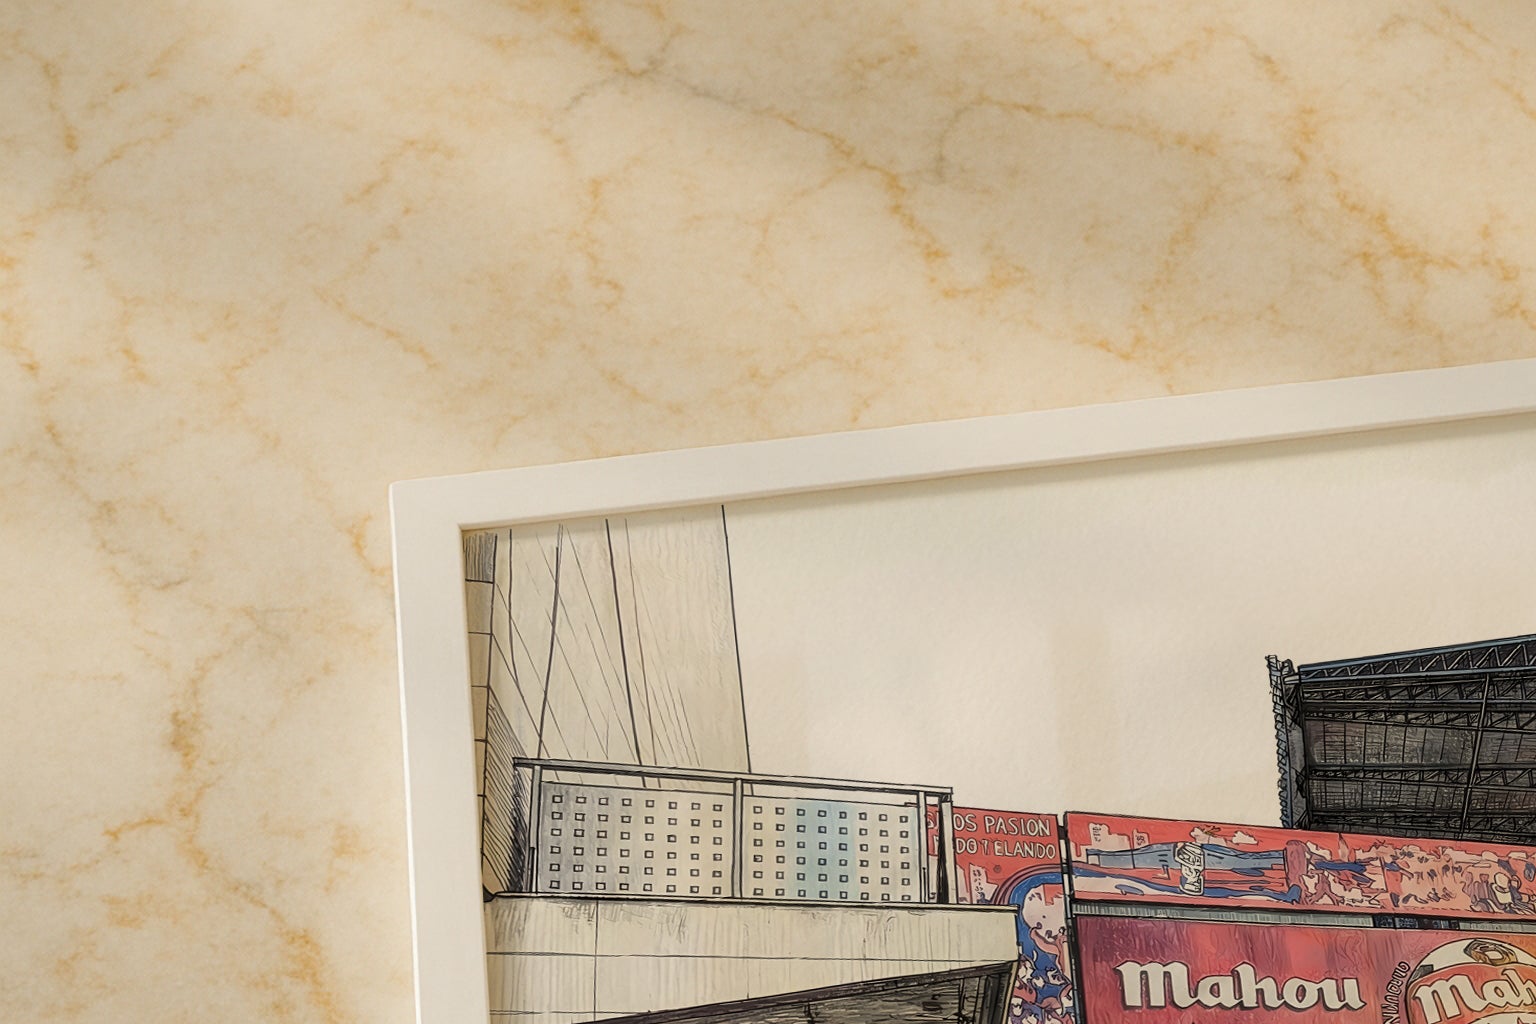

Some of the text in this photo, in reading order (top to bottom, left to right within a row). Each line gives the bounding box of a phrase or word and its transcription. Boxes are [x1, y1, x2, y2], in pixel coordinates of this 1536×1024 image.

[984, 816, 1051, 837] PASION
[994, 841, 1056, 860] ELANDO
[1113, 960, 1367, 1010] Mahou
